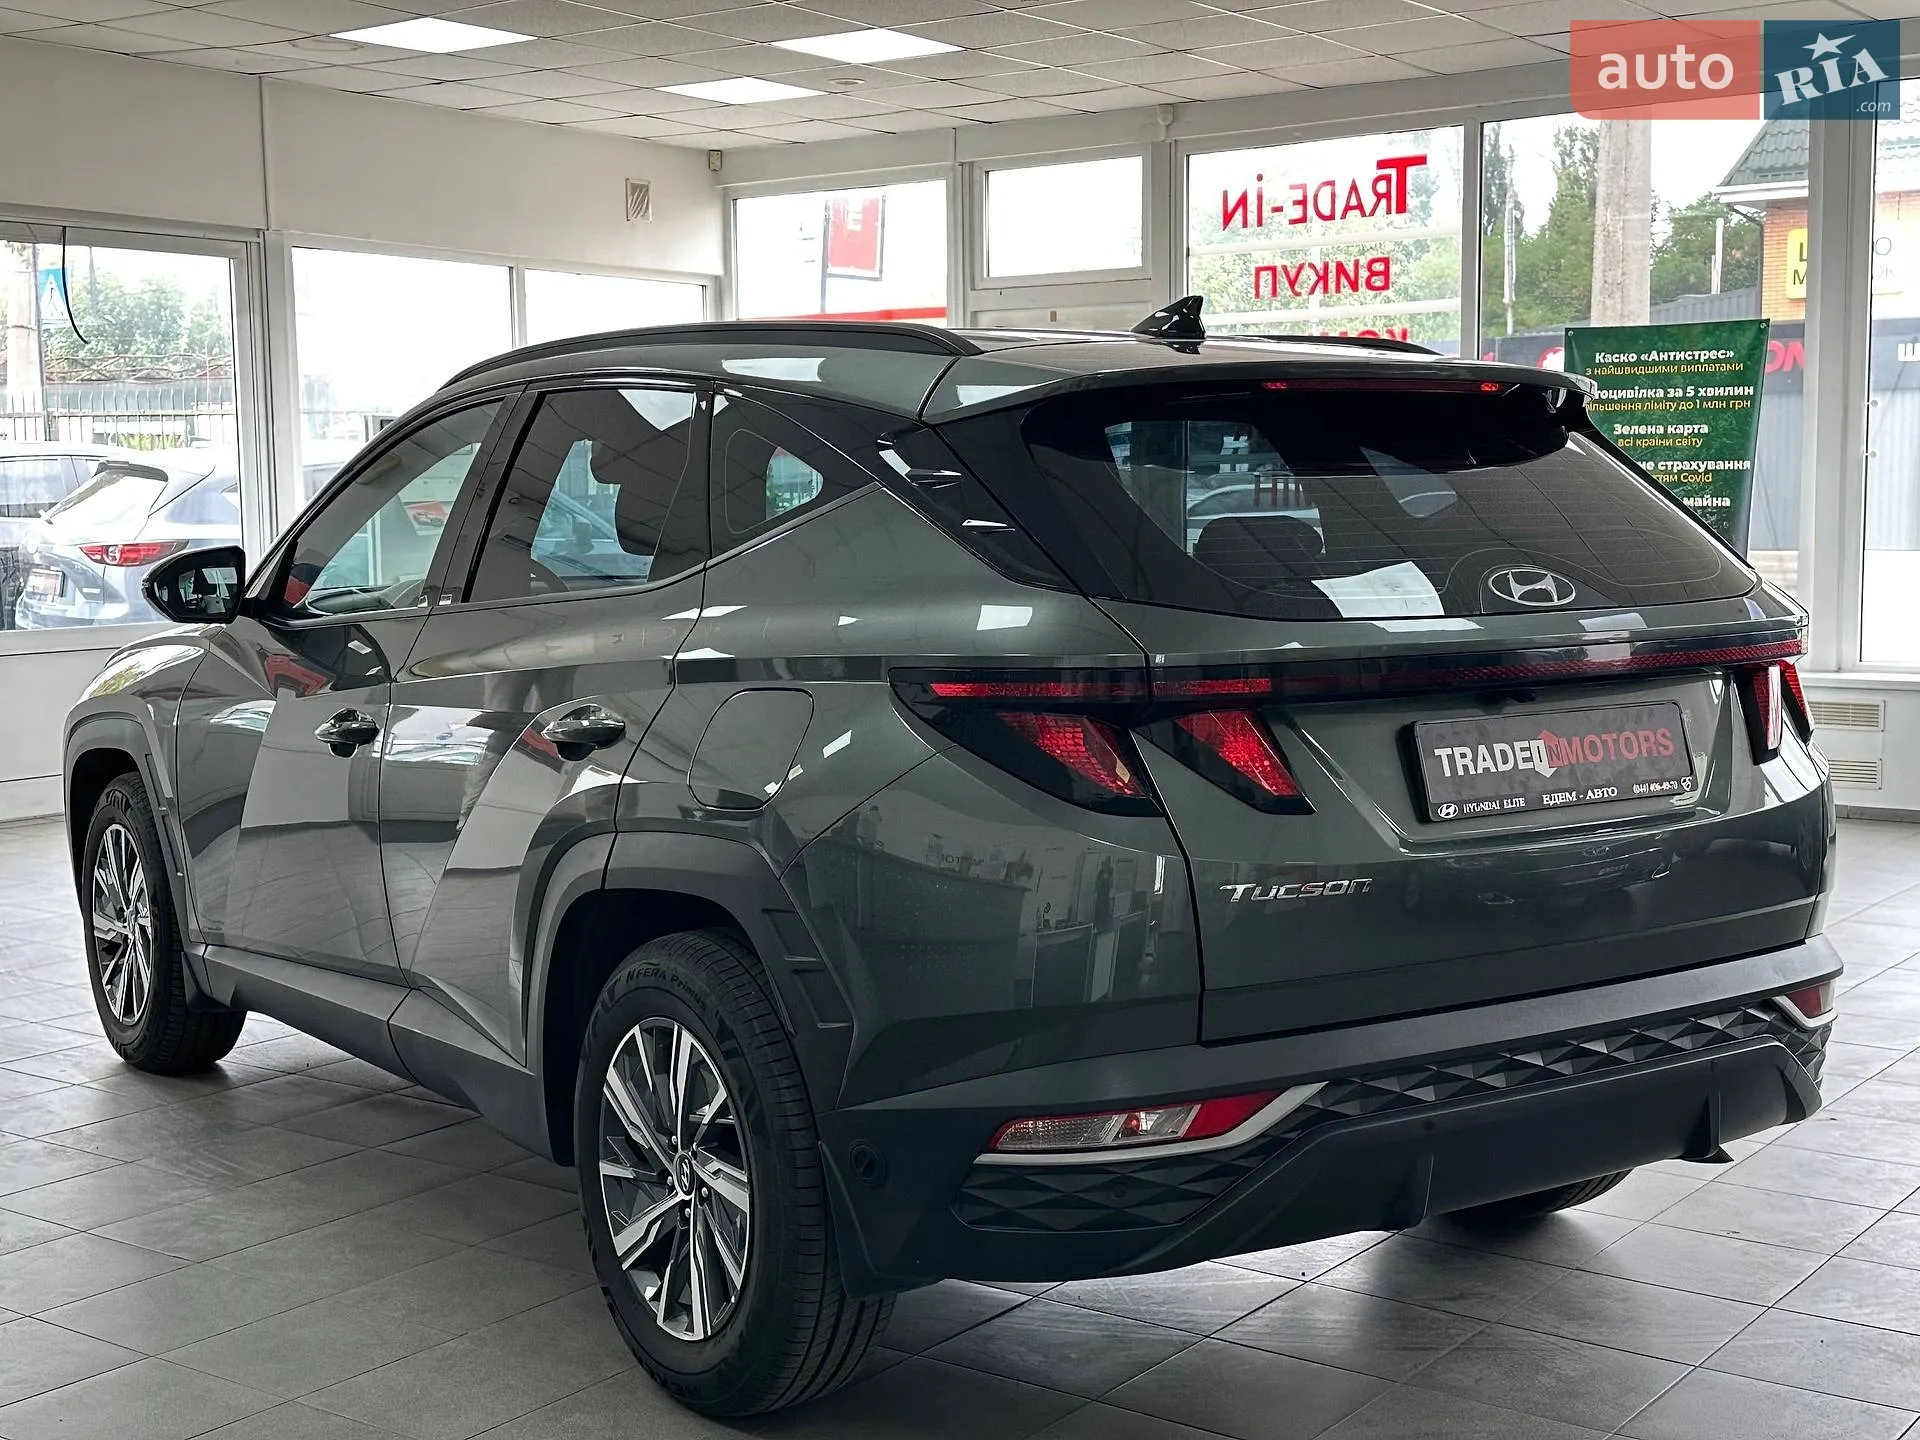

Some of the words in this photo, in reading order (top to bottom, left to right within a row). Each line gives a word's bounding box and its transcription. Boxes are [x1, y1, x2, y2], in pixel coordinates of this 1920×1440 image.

[1595, 352, 1637, 363] Каско
[1641, 349, 1734, 362] «Антистрес»
[1585, 367, 1593, 375] з
[1595, 363, 1678, 375] найшвидшими
[1681, 361, 1743, 373] виплатами
[1667, 388, 1681, 398] за
[1685, 386, 1694, 397] 5
[1698, 385, 1754, 397] хвилин
[1644, 400, 1676, 412] ліміту
[1679, 401, 1693, 411] до
[1703, 401, 1726, 410] млн
[1730, 400, 1751, 411] грн
[1613, 424, 1664, 435] Зелена
[1668, 424, 1708, 437] карта
[1617, 438, 1633, 447] всі
[1675, 437, 1703, 447] світу
[1657, 460, 1751, 473] страхування
[1680, 472, 1713, 483] Covid
[1682, 494, 1731, 507] майна
[1463, 800, 1500, 813] HYUNDAI
[1504, 798, 1525, 809] ELITE
